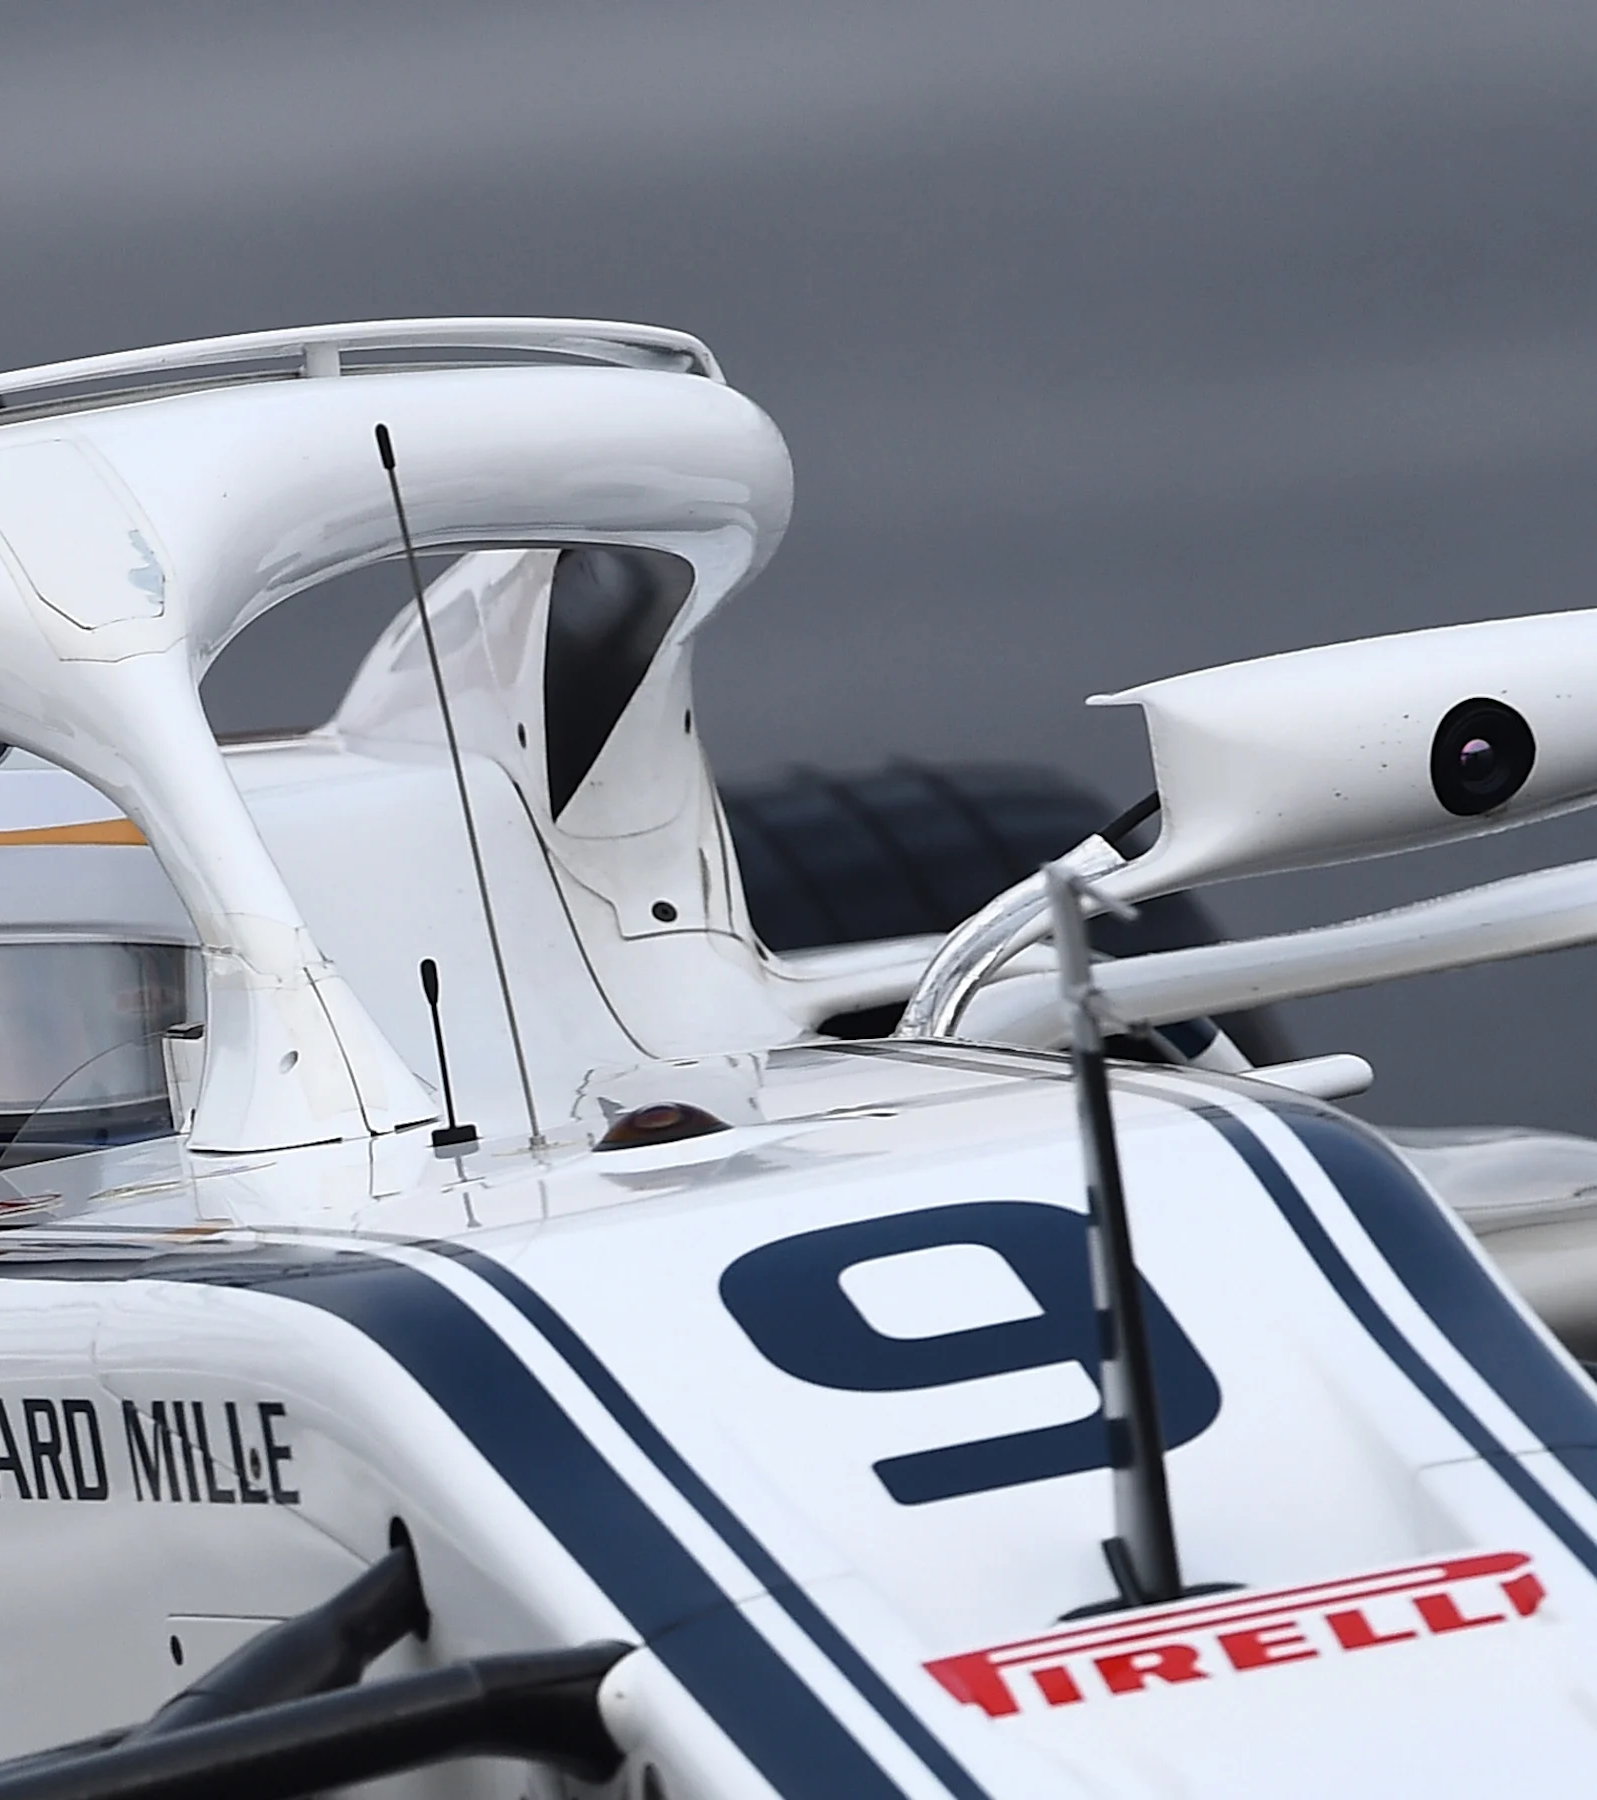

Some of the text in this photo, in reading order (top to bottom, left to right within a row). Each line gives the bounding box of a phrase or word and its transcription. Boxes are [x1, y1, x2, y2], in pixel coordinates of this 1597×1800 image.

[718, 1199, 1223, 1506] 9
[121, 1399, 300, 1505] MILLE
[922, 1551, 1548, 1719] PIRELLI
